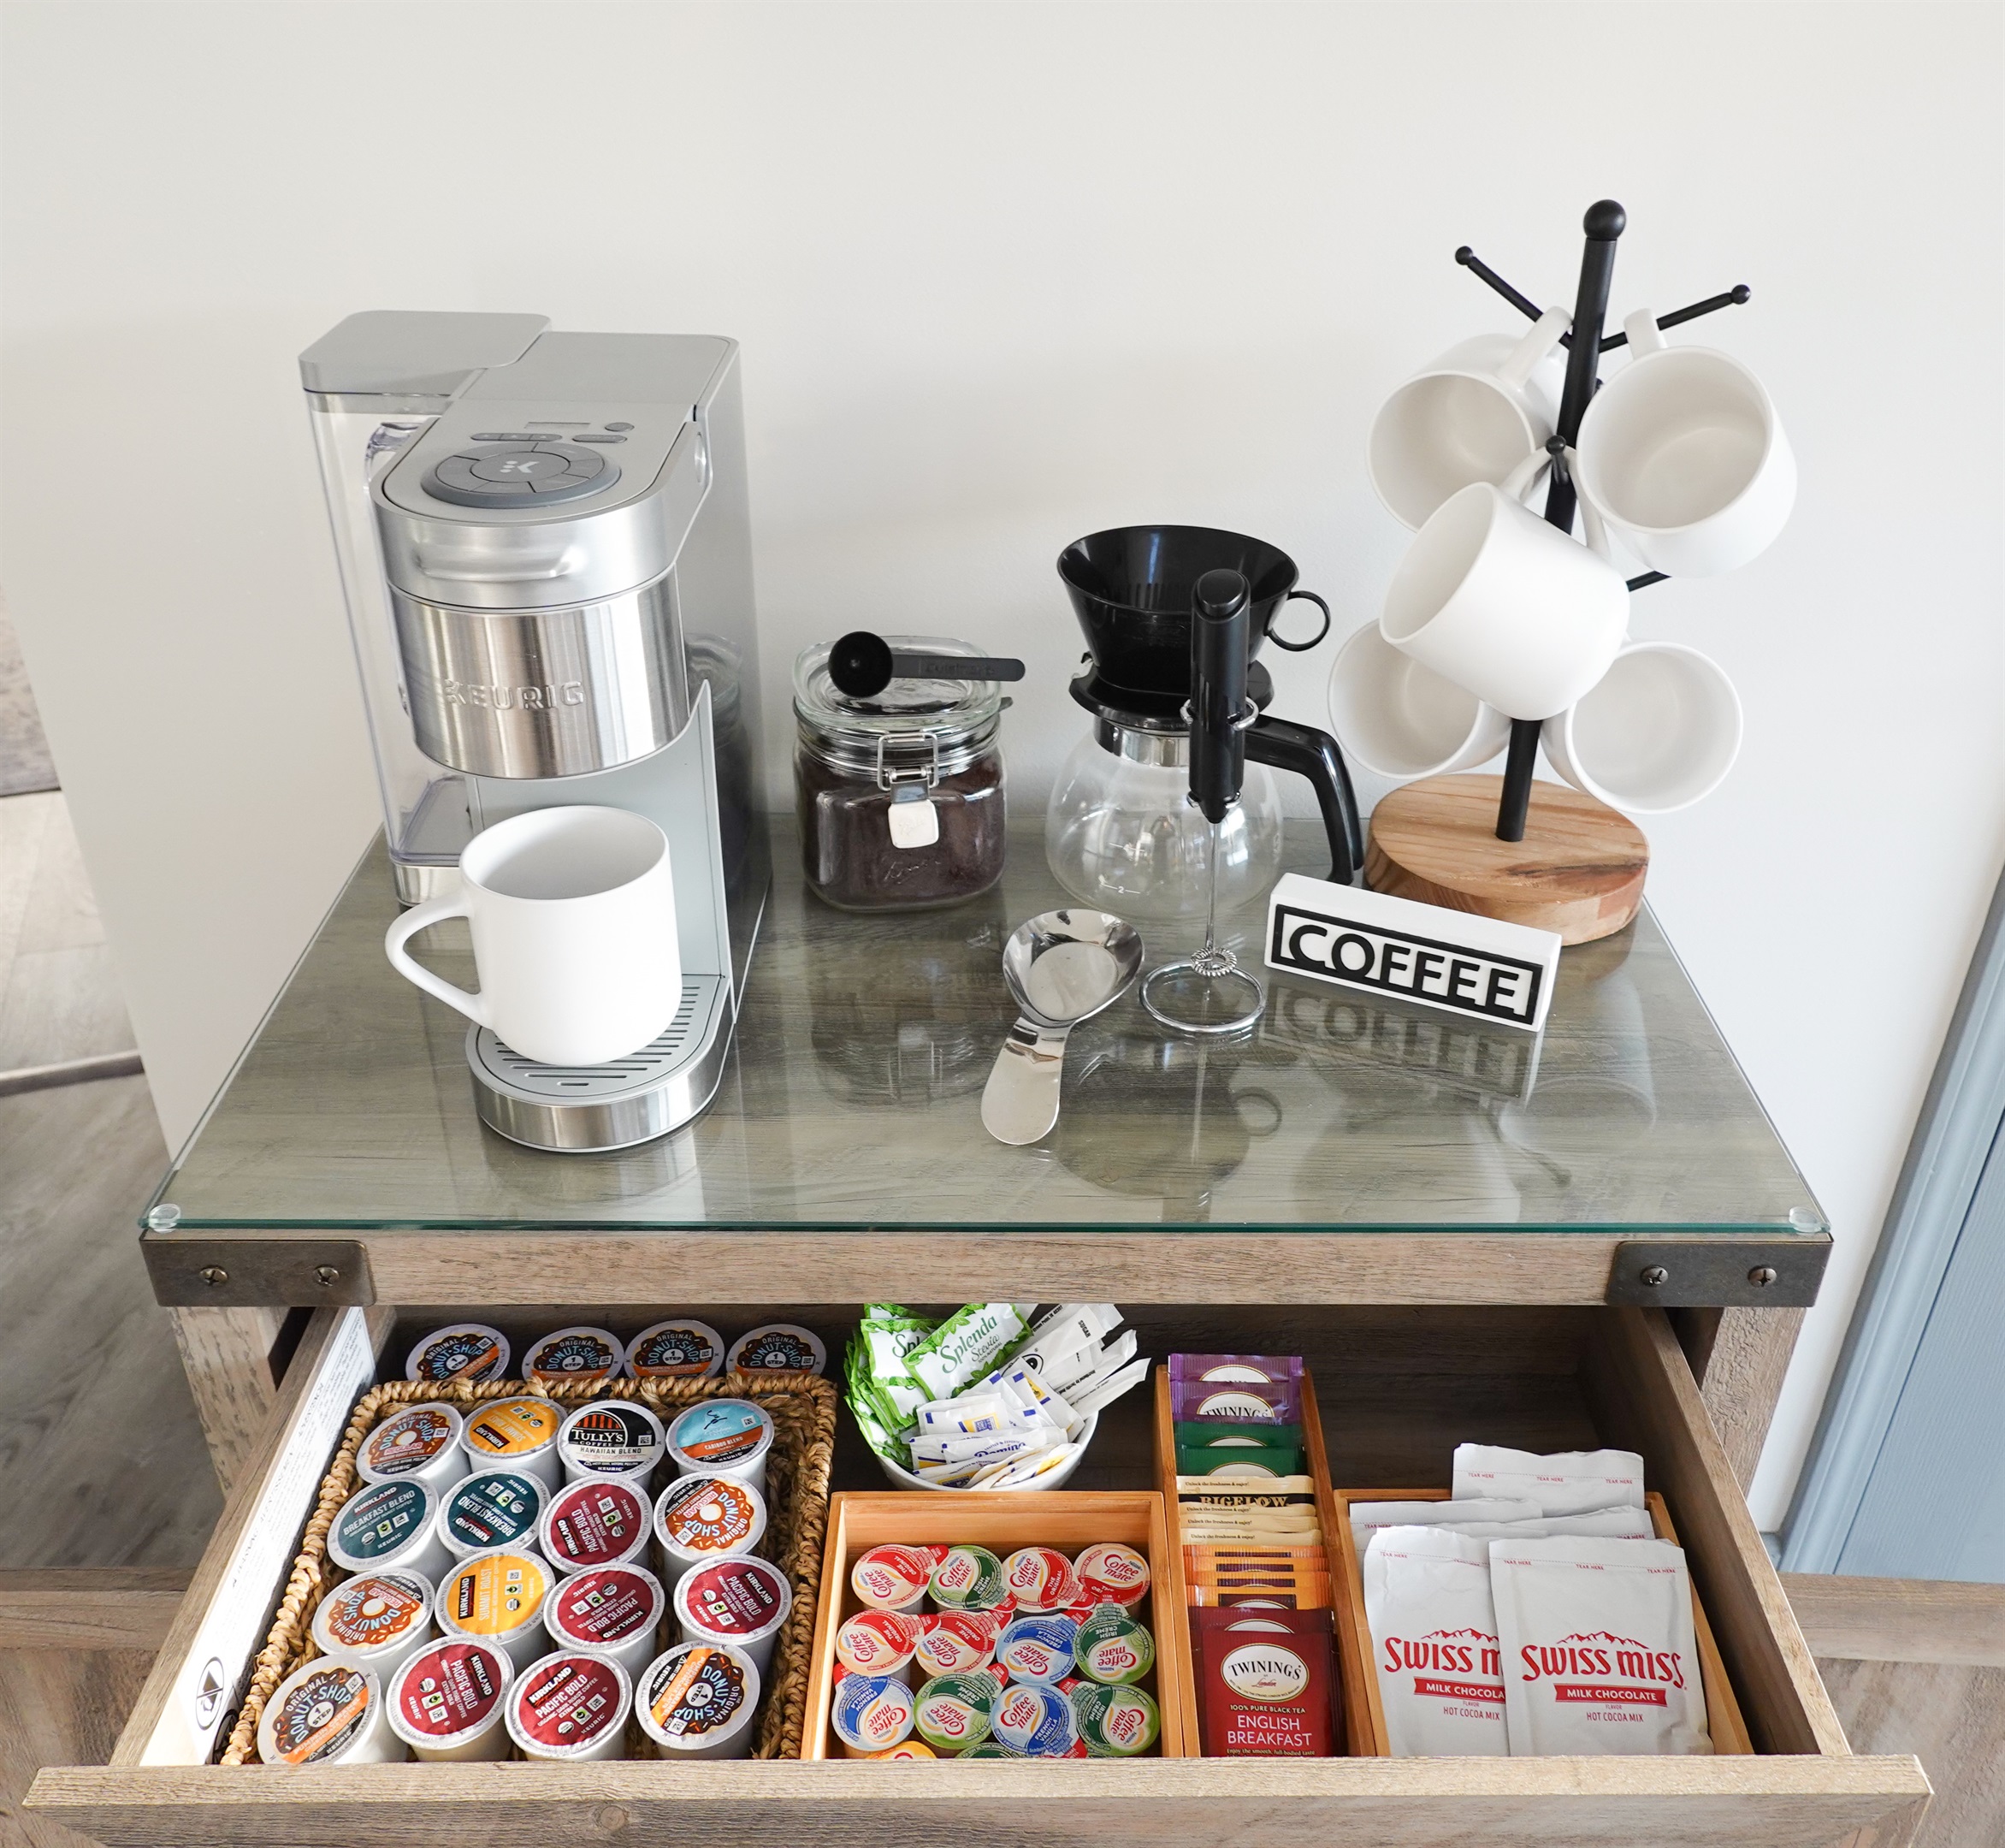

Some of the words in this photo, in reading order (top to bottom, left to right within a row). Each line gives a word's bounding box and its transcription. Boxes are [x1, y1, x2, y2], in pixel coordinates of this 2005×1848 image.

[445, 678, 585, 710] KEURIG
[1289, 924, 1519, 1016] COFFEE
[762, 1336, 797, 1345] ORIGINAL
[1078, 1320, 1091, 1338] SUGAR
[426, 1338, 459, 1359] ORIGINAL
[648, 1339, 677, 1365] DONUT
[679, 1341, 700, 1362] SHOP
[750, 1342, 781, 1366] DONUT
[783, 1344, 801, 1368] SHOP
[941, 1316, 998, 1373] Splenda
[971, 1334, 1000, 1362] Stevia
[432, 1349, 450, 1379] DONUT
[452, 1344, 483, 1355] SHOP
[547, 1346, 579, 1369] DONUT
[581, 1348, 599, 1369] SHOP
[396, 1413, 434, 1425] ORIGINAL
[380, 1420, 416, 1450] DONUT
[416, 1420, 435, 1442] SHOP
[476, 1427, 505, 1448] KIRKLAND
[571, 1430, 624, 1442] TULLY'S
[507, 1479, 528, 1496] KEURIG
[354, 1487, 397, 1513] KIRKLAND
[458, 1496, 482, 1514] BLEND
[620, 1499, 634, 1519] KEURIG
[684, 1491, 717, 1518] REGULAR
[718, 1492, 739, 1531] DONUT
[1199, 1496, 1288, 1507] BIGELOW
[343, 1504, 388, 1536] BREAKFAST
[388, 1490, 416, 1508] BLEND
[479, 1509, 516, 1537] BREAKFAST
[571, 1509, 586, 1529] BOLD
[377, 1532, 403, 1549] KEURIG
[455, 1517, 491, 1543] KIRKLAND
[558, 1519, 579, 1555] KIRKLAND
[580, 1527, 600, 1552] PACIFIC
[684, 1520, 720, 1537] SHOP
[714, 1518, 748, 1545] ORIGINAL
[939, 1559, 967, 1587] Coffee
[955, 1566, 972, 1588] mate
[1009, 1557, 1034, 1588] Coffee
[1026, 1562, 1041, 1586] mate
[1104, 1554, 1139, 1578] Coffee
[1104, 1568, 1133, 1582] mate
[480, 1568, 492, 1589] ROAST
[573, 1580, 596, 1597] KEURIG
[745, 1573, 773, 1604] KIRKLAND
[865, 1572, 891, 1598] Coffee
[874, 1569, 898, 1588] mate
[973, 1577, 985, 1591] IRISH
[1050, 1570, 1062, 1596] ORIGINAL
[344, 1591, 366, 1621] SHOP
[368, 1588, 403, 1608] REGULAR
[460, 1578, 470, 1617] KIRKLAND
[479, 1591, 491, 1621] SUMMIT
[727, 1576, 750, 1601] PACIFIC
[743, 1598, 761, 1615] BOLD
[349, 1608, 401, 1631] DONUT
[608, 1597, 638, 1620] PACIFIC
[695, 1604, 712, 1623] KEURIG
[334, 1619, 366, 1641] ORIGINAL
[587, 1617, 611, 1632] BOLD
[602, 1610, 643, 1638] KIRKLAND
[849, 1633, 873, 1662] Coffee
[859, 1632, 880, 1654] mate
[926, 1638, 956, 1667] Coffee
[939, 1635, 961, 1656] mate
[1022, 1645, 1050, 1661] mate
[1098, 1646, 1127, 1658] mate
[1014, 1650, 1048, 1675] Coffee
[1097, 1652, 1137, 1668] Coffee
[1228, 1661, 1301, 1680] TWININGS
[450, 1660, 470, 1691] PACIFIC
[461, 1687, 478, 1709] BOLD
[470, 1655, 493, 1696] KIRKLAND
[529, 1667, 572, 1703] KIRKLAND
[653, 1665, 672, 1691] KEURIG
[701, 1665, 729, 1706] DONUT
[1251, 1678, 1276, 1688] London
[286, 1676, 328, 1711] ORIGINAL
[535, 1691, 568, 1719] PACIFIC
[565, 1674, 588, 1697] BOLD
[690, 1685, 704, 1703] STEP
[1426, 1683, 1452, 1694] MILK
[1566, 1689, 1593, 1699] MILK
[1594, 1690, 1658, 1701] CHOCOLATE
[290, 1694, 315, 1744] DONUT
[318, 1685, 352, 1704] SHOP
[408, 1696, 423, 1720] KEURIG
[558, 1705, 574, 1719] EXTRA
[574, 1696, 586, 1707] BOLD
[674, 1705, 715, 1721] SHOP
[710, 1685, 740, 1723] ORIGINAL
[869, 1704, 890, 1727] mate
[940, 1703, 967, 1721] mate
[1000, 1696, 1031, 1727] Coffee
[1017, 1703, 1038, 1729] mate
[1443, 1706, 1458, 1715] HOT
[1459, 1709, 1484, 1719] COCOA
[1485, 1711, 1500, 1721] MIX
[312, 1708, 332, 1725] STEP
[582, 1713, 606, 1734] KEURIG
[872, 1707, 907, 1735] Coffee
[931, 1709, 964, 1736] Coffee
[1034, 1715, 1052, 1740] FRENCH
[1110, 1709, 1127, 1735] mate
[1117, 1709, 1145, 1740] Coffee
[1237, 1715, 1300, 1731] ENGLISH
[1587, 1712, 1601, 1721] HOT
[1603, 1712, 1627, 1721] COCOA
[1629, 1713, 1644, 1723] MIX
[327, 1728, 352, 1754] KEURIG
[1039, 1719, 1058, 1742] VANILLA
[1227, 1731, 1312, 1746] BREAKFAST
